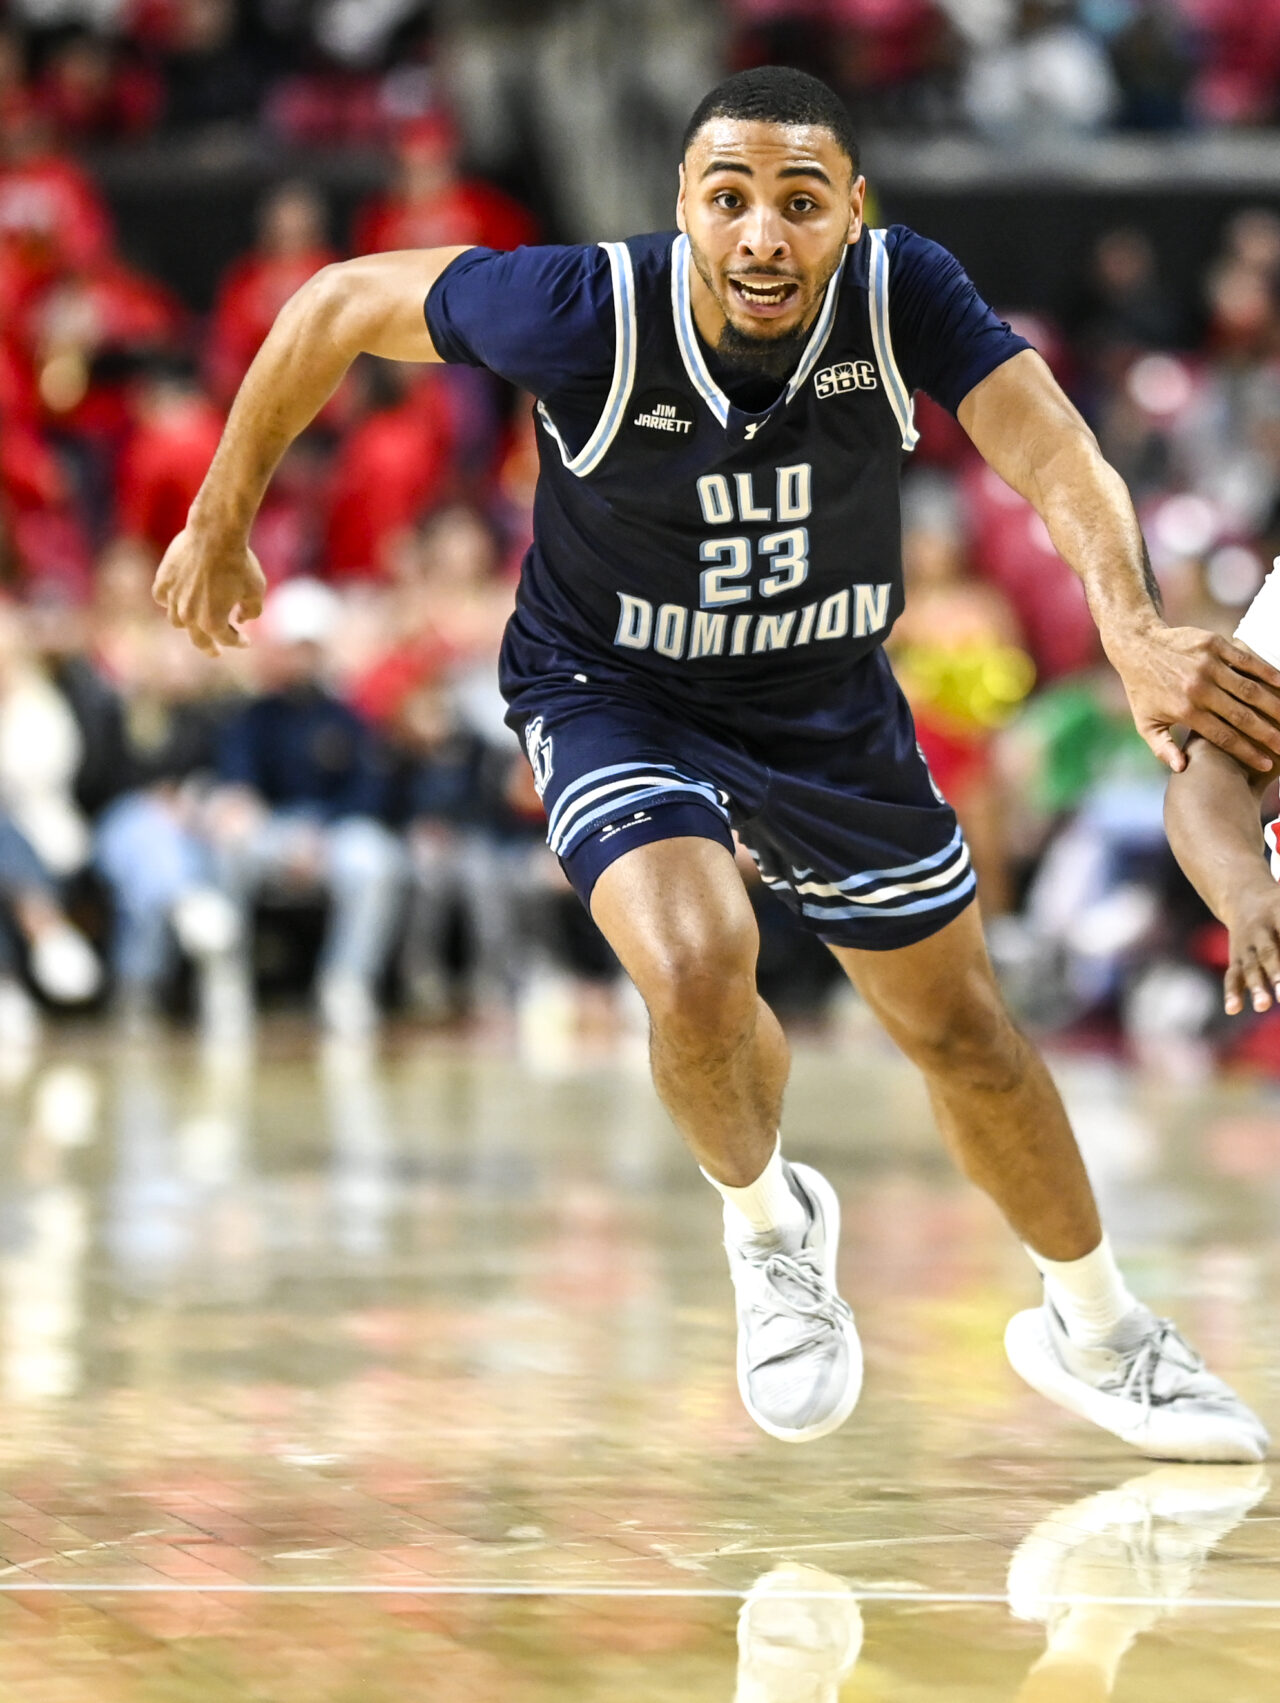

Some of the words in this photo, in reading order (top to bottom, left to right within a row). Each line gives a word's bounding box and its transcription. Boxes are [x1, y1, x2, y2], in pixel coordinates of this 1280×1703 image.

[814, 360, 877, 399] SBC
[634, 413, 692, 433] JARRETT
[652, 403, 676, 418] JIM
[697, 462, 812, 525] OLD
[699, 526, 810, 609] 23
[615, 583, 891, 660] DOMINION
